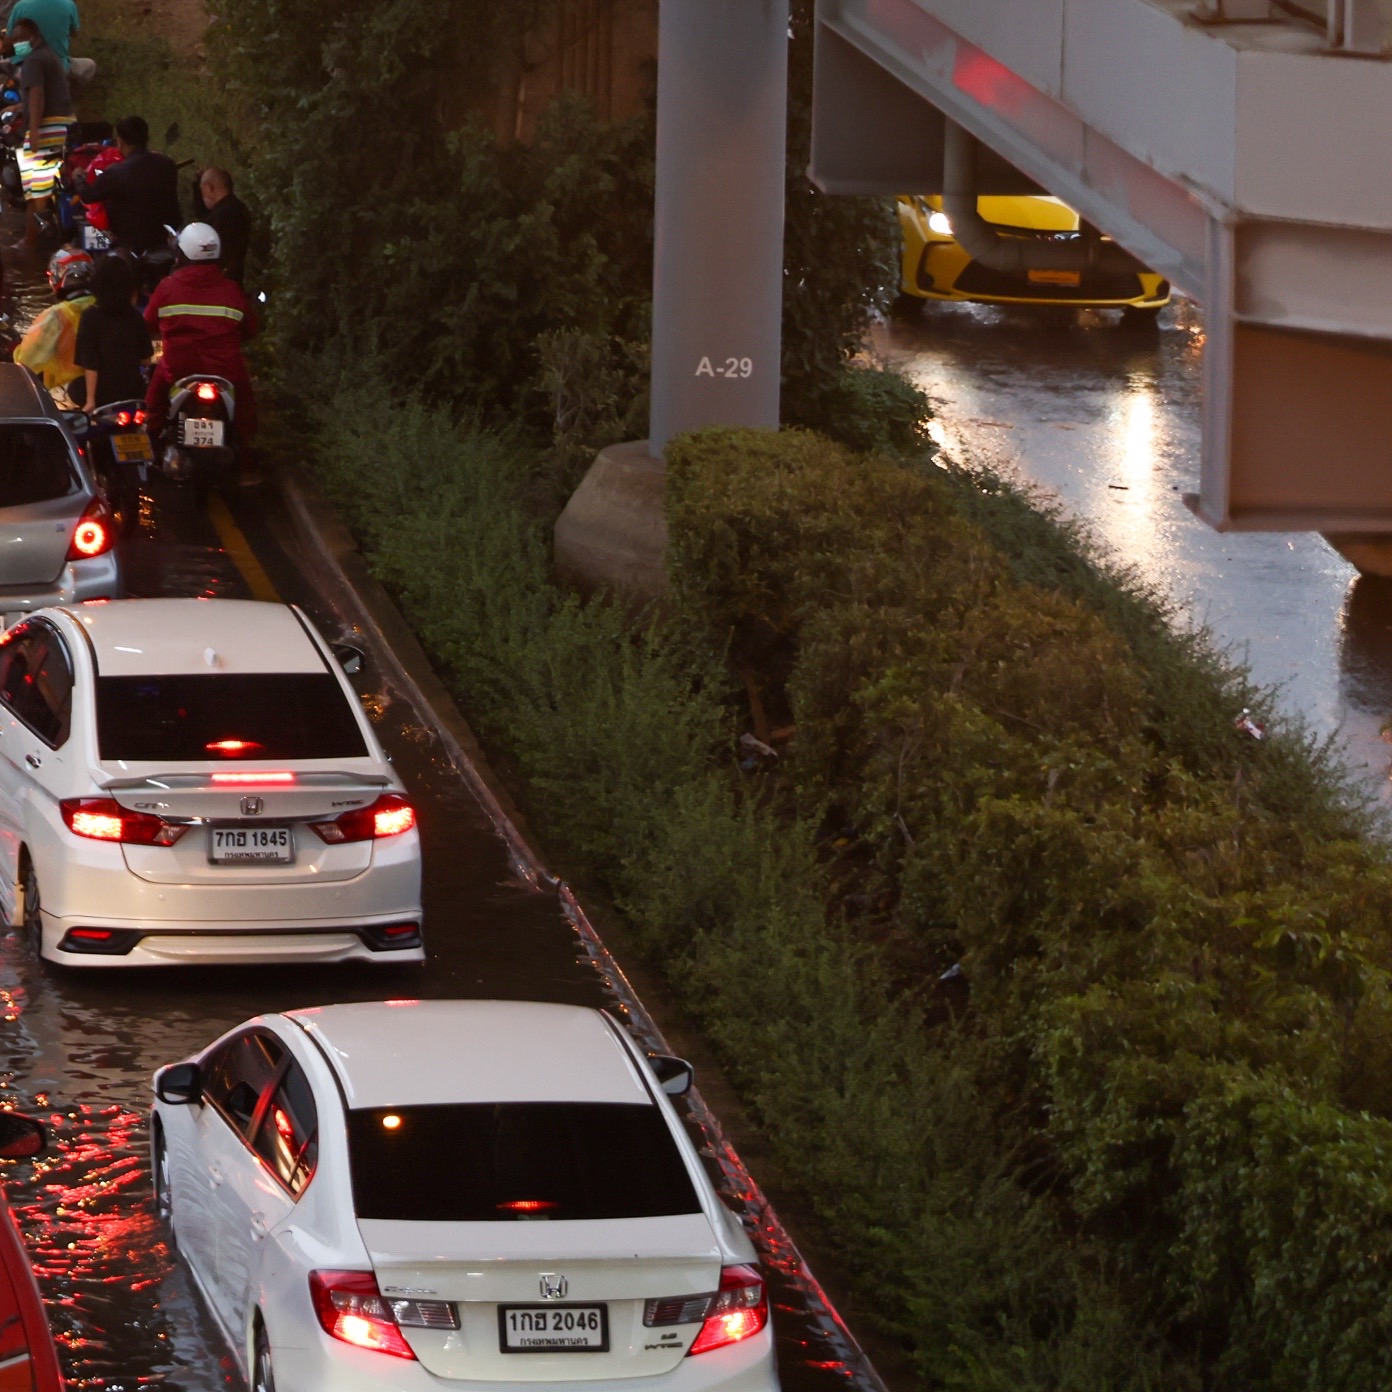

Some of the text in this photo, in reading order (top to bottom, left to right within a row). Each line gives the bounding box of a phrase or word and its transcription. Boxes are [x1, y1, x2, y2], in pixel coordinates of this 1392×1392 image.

[695, 357, 753, 379] A-29
[194, 437, 214, 445] 374
[252, 831, 287, 846] 1845
[553, 1312, 598, 1330] 2046
[520, 1336, 589, 1345] กรุงเทพมหานคร
